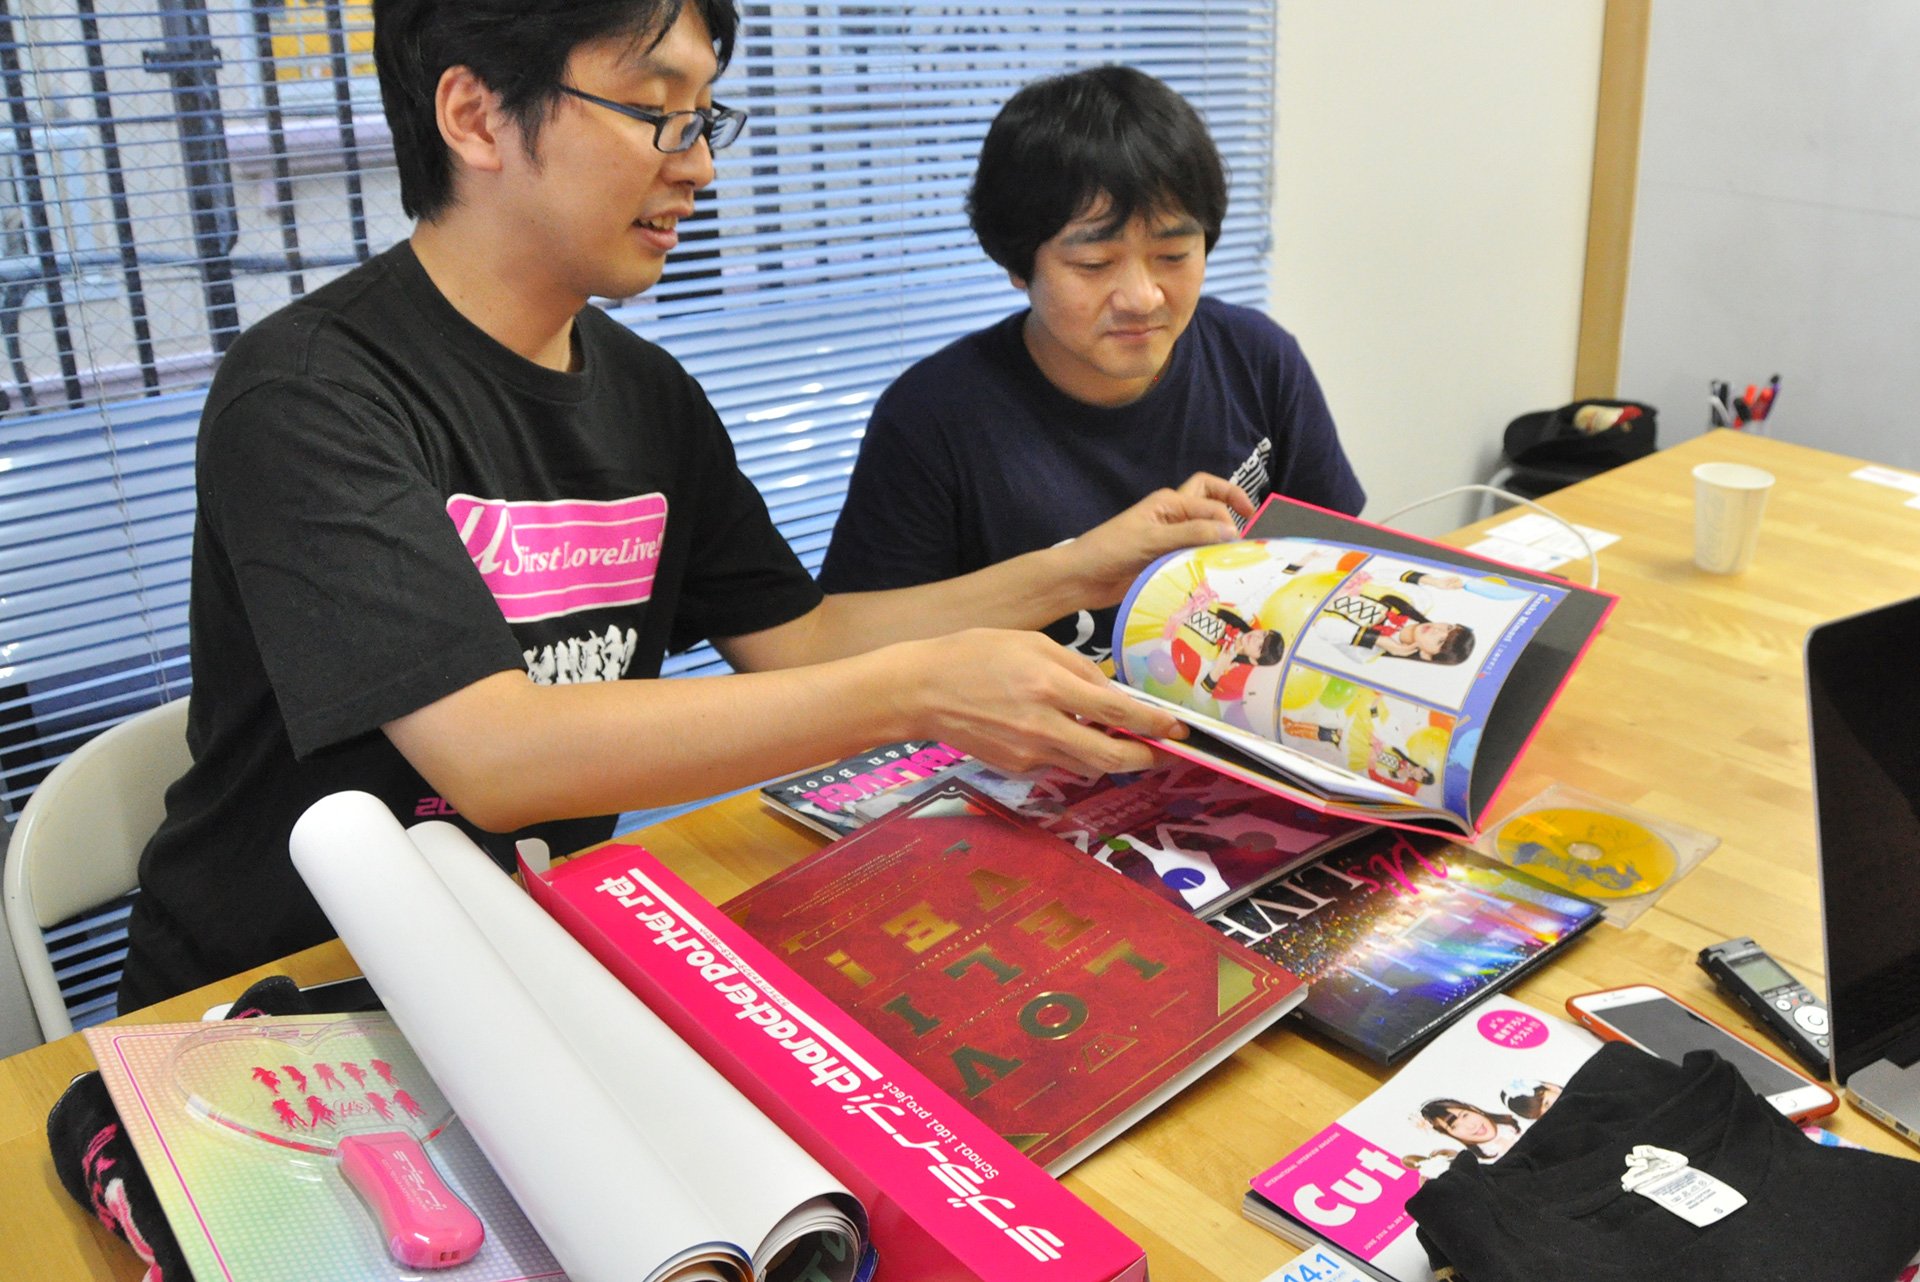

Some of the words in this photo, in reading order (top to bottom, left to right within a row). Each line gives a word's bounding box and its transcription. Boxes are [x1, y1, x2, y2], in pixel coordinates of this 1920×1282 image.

[867, 743, 920, 766] Fan
[787, 768, 856, 795] Book
[882, 1081, 932, 1120] project
[953, 1142, 999, 1180] School
[1293, 1147, 1407, 1227] Cut
